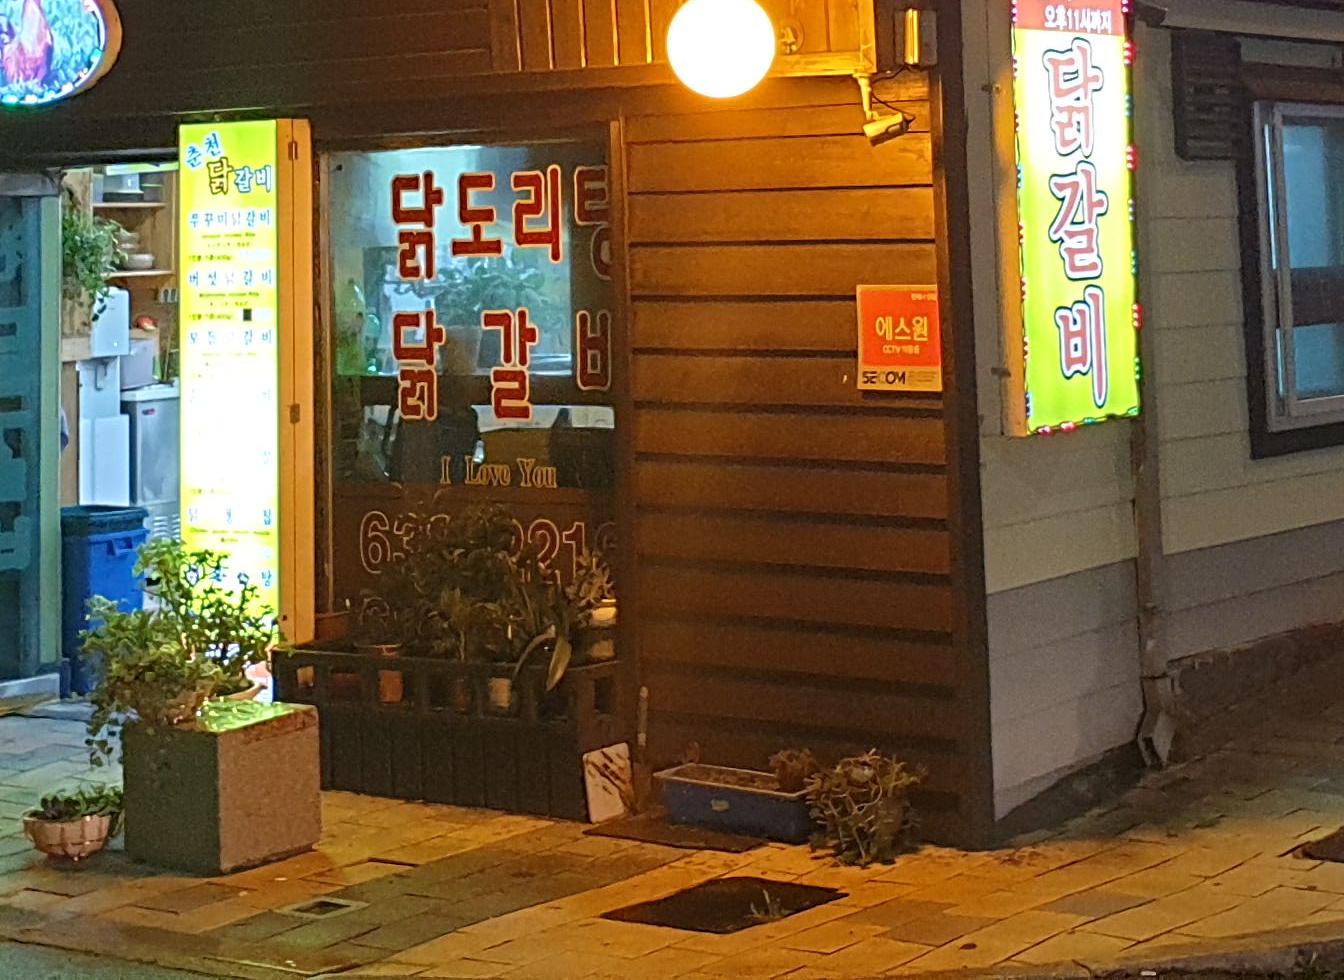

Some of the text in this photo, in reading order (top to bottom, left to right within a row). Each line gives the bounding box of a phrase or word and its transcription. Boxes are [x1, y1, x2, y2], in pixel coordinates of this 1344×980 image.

[186, 131, 222, 169] 춘천
[205, 156, 273, 196] 닭갈비
[1042, 37, 1109, 409] 닭갈비
[875, 316, 929, 342] 에스원
[861, 370, 907, 385] SECOM
[440, 454, 558, 489] I Love You
